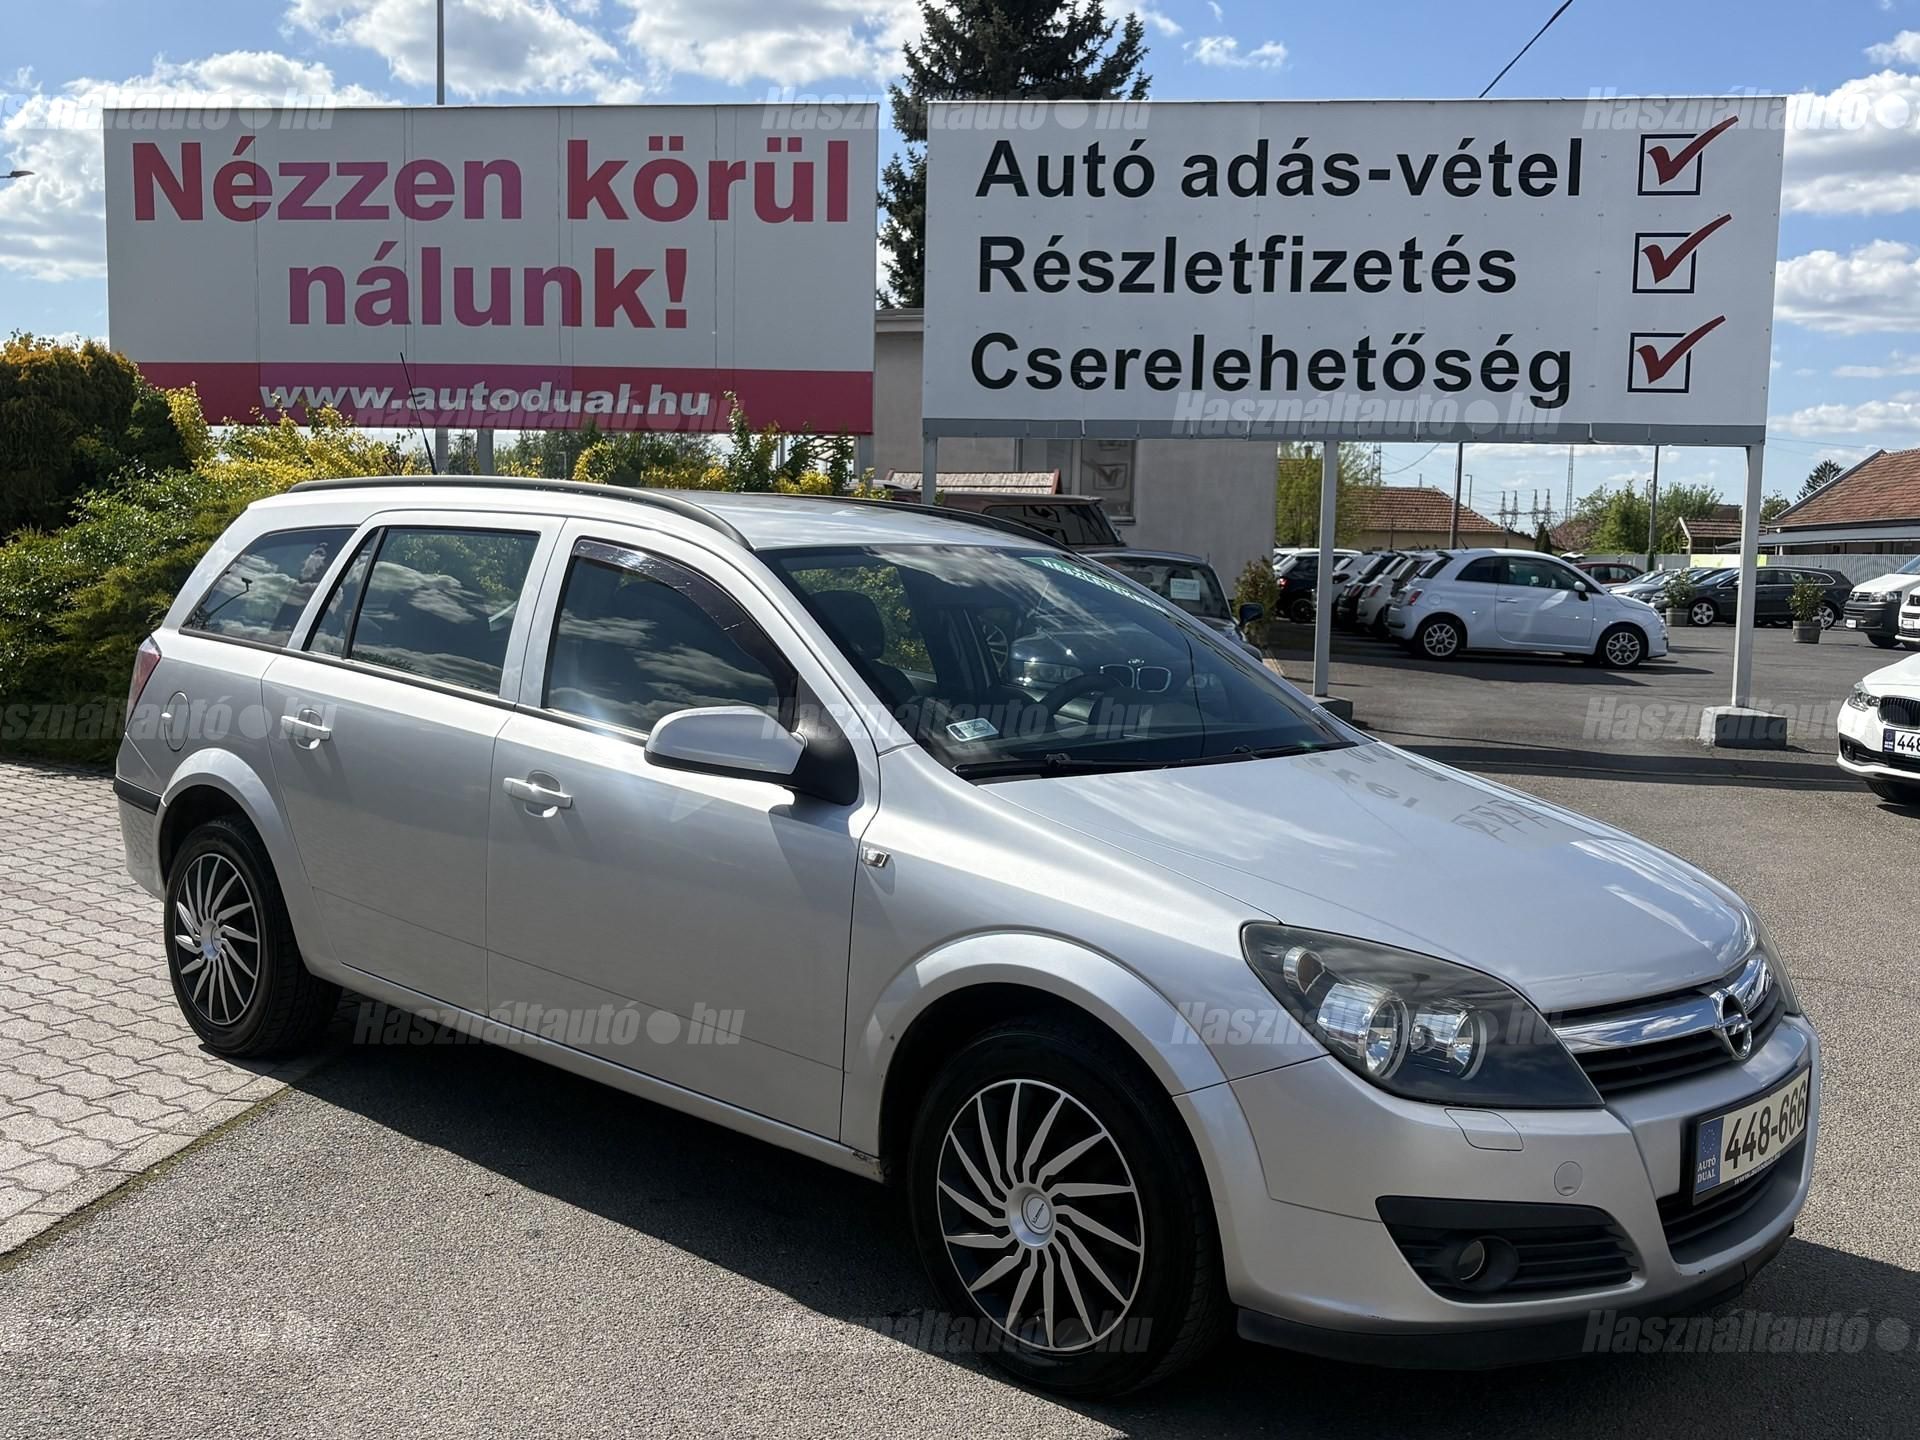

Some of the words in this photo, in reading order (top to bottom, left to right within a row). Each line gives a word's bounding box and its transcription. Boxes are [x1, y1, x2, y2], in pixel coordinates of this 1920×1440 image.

[132, 135, 522, 222] Nézzen
[567, 135, 849, 224] körül
[976, 138, 1155, 198] Autó
[1181, 136, 1583, 198] adás-vétel
[289, 240, 688, 328] nálunk!
[979, 233, 1517, 294] Részletfizetés
[259, 380, 711, 416] www.autodual.hu
[971, 331, 1572, 410] Cserelehetőség
[1725, 1080, 1807, 1169] 448-666
[1697, 1155, 1716, 1172] AUTÓ
[1697, 1168, 1716, 1184] DUAL
